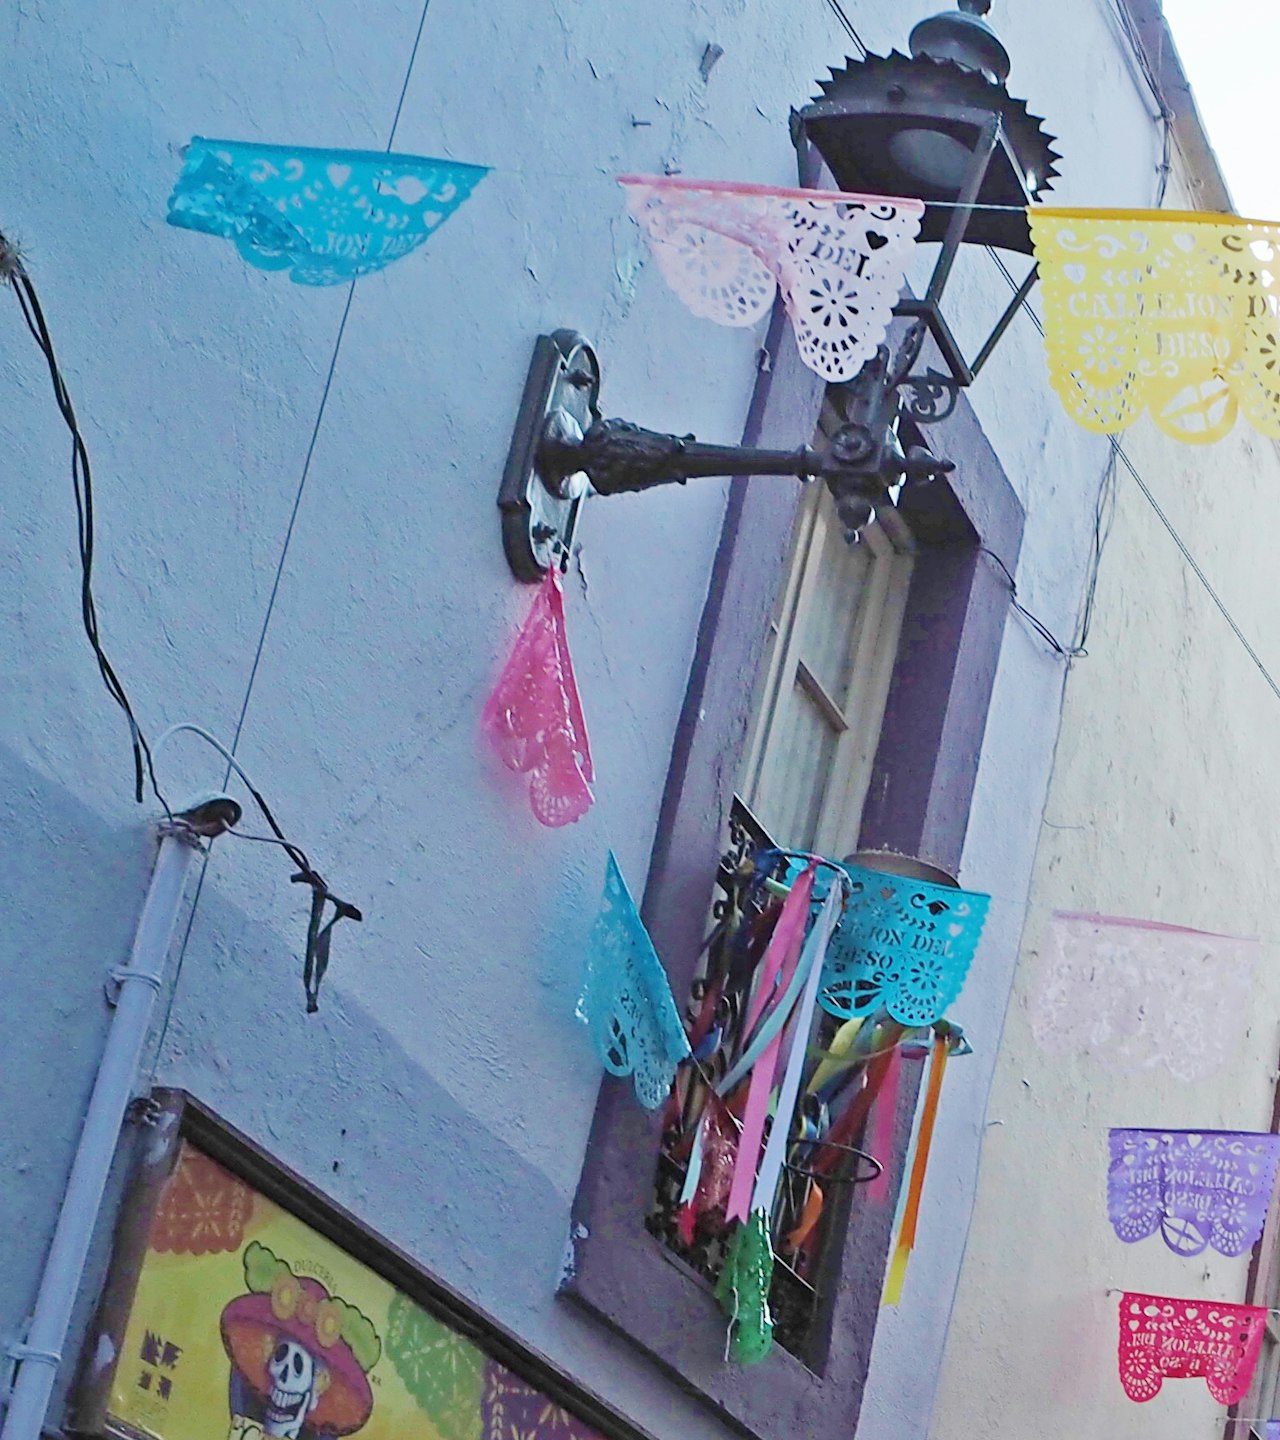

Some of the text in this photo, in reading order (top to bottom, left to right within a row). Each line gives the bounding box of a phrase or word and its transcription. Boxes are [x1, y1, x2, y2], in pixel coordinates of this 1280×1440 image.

[811, 239, 874, 282] DEL
[1067, 291, 1236, 321] CALLEJON
[1157, 332, 1231, 359] BESO
[911, 934, 954, 959] DEL
